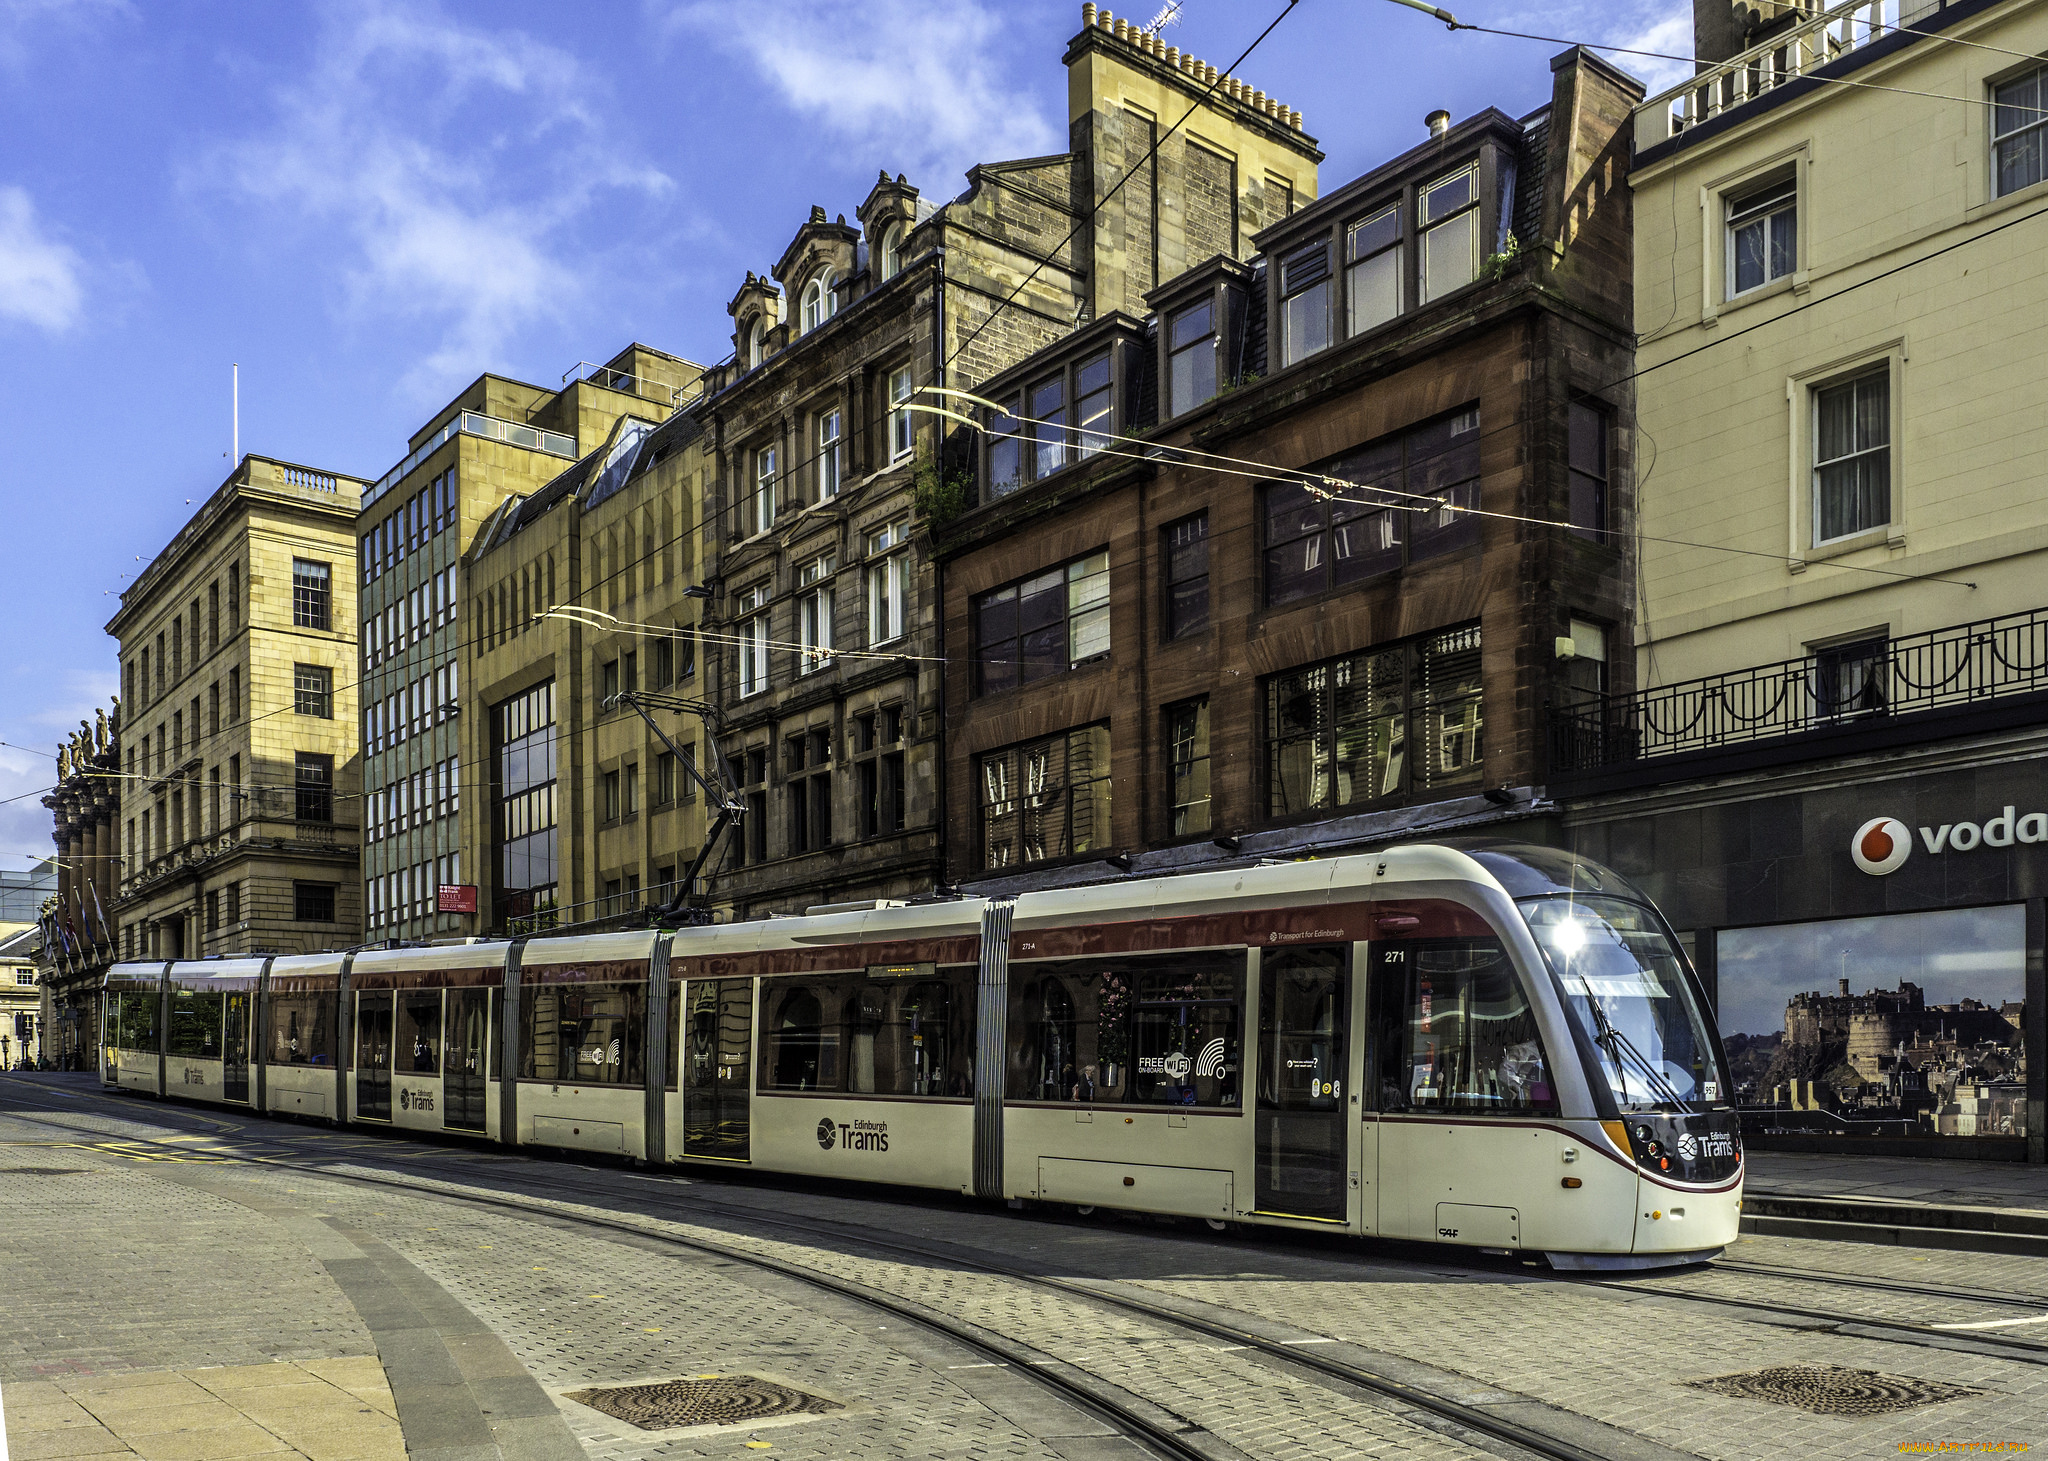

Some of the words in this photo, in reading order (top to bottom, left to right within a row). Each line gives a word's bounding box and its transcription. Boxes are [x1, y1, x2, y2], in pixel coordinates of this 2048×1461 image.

[1918, 805, 2048, 854] voda
[1277, 932, 1304, 940] Transport
[1305, 930, 1313, 938] for
[1314, 929, 1344, 938] Edinburgh
[1385, 951, 1405, 962] 271
[1139, 1057, 1164, 1067] FREE
[1705, 1086, 1715, 1095] 957
[410, 1092, 434, 1111] Trams
[854, 1119, 888, 1132] Edinburgh
[838, 1124, 888, 1152] Trams
[1710, 1132, 1730, 1141] Edinburgh
[1698, 1137, 1733, 1157] Trams
[1438, 1228, 1458, 1238] CAF
